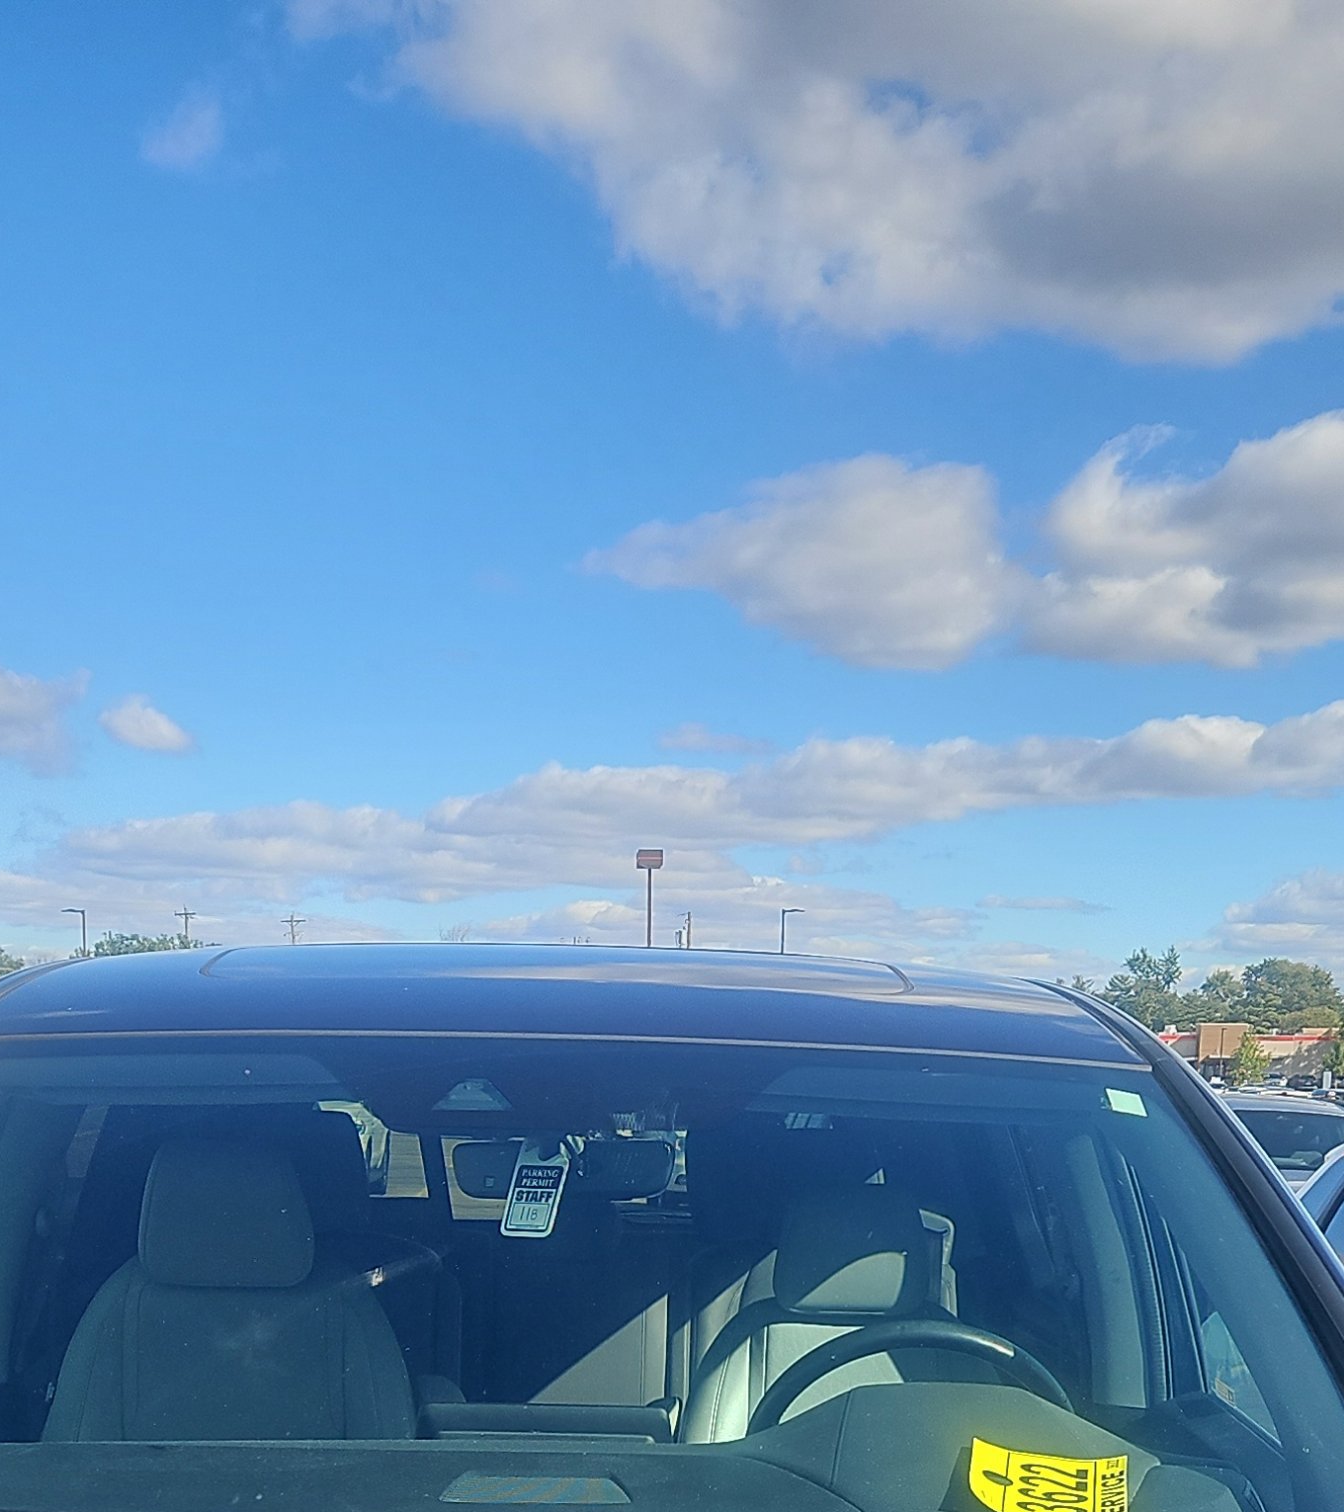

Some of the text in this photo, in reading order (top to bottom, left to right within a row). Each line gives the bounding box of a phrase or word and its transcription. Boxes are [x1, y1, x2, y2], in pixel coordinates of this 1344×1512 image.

[521, 1168, 559, 1178] PARKING
[521, 1178, 555, 1187] PERMIT
[515, 1189, 554, 1203] STAFF
